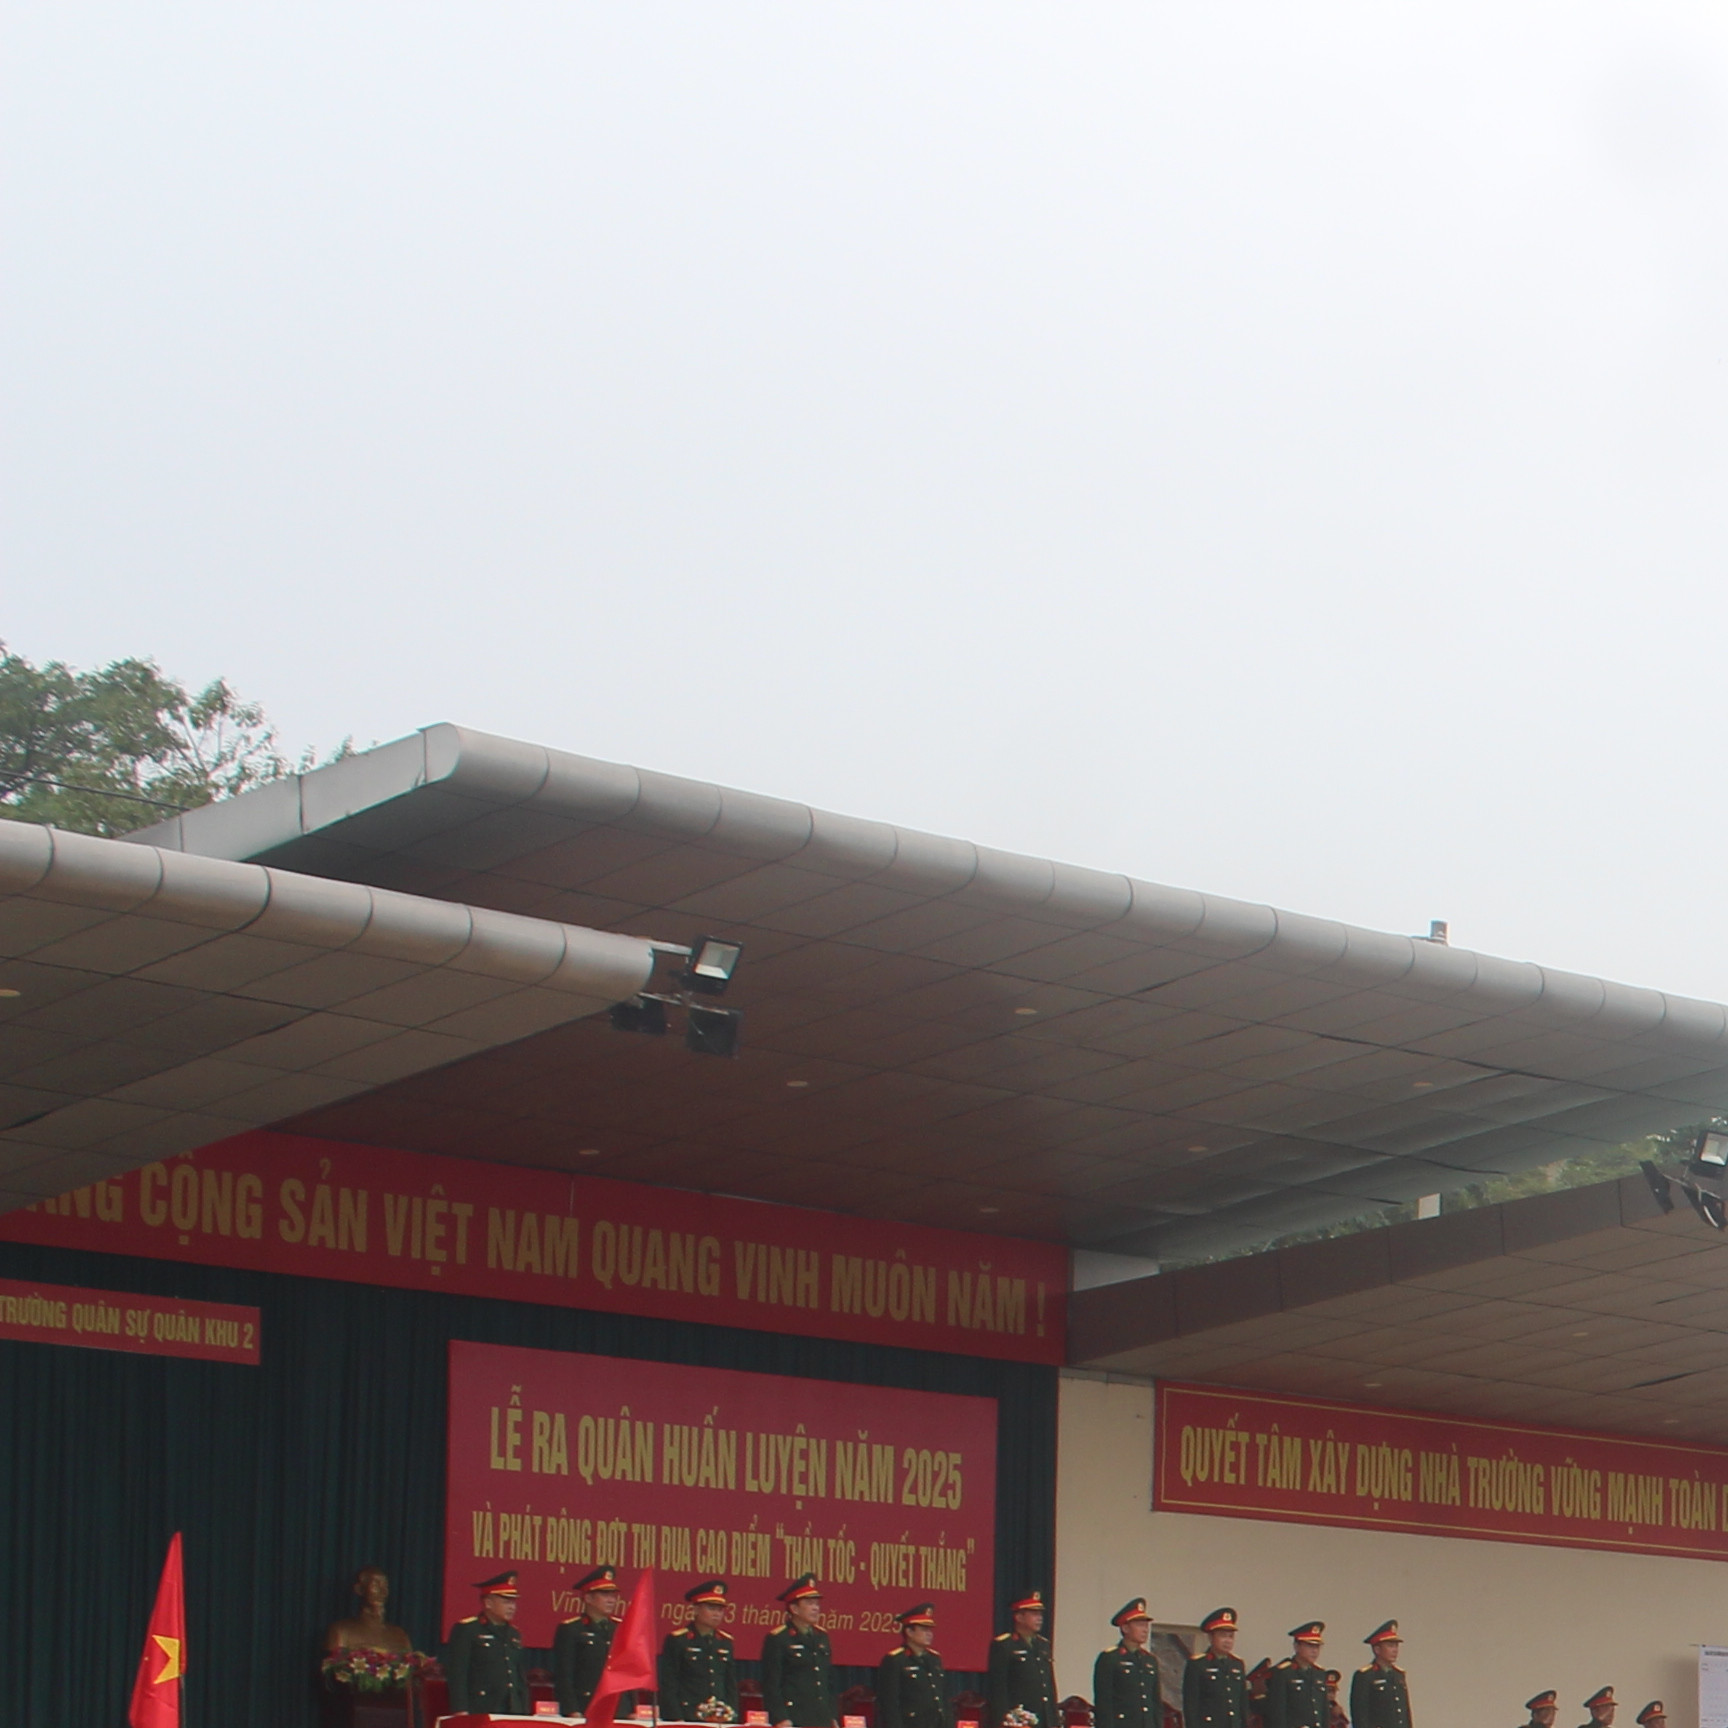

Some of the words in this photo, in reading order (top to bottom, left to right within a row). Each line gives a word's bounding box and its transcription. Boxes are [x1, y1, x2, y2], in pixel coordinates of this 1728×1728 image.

[278, 1157, 368, 1253] SẢN
[384, 1183, 474, 1277] VIỆT
[487, 1207, 580, 1279] NAM
[591, 1219, 720, 1297] QUANG
[734, 1240, 820, 1309] VINH
[830, 1248, 937, 1325] MUÔN
[947, 1259, 1027, 1336] NĂM
[72, 1300, 121, 1335] QUÂN
[125, 1308, 152, 1344] SỰ
[153, 1310, 202, 1344] QUÂN
[205, 1317, 240, 1348] KHU
[243, 1322, 254, 1349] 2
[490, 1385, 523, 1472] LỄ
[532, 1410, 569, 1476] RA
[577, 1405, 655, 1486] QUÂN
[662, 1406, 737, 1490] HUẤN
[745, 1423, 828, 1510] LUYỆN
[834, 1429, 895, 1504] NĂM
[901, 1447, 963, 1511] 2025
[1180, 1413, 1250, 1487] QUYẾT
[1255, 1423, 1301, 1490] TÂM
[1308, 1429, 1350, 1496] XÂY
[1356, 1441, 1413, 1511] DỰNG
[1419, 1442, 1461, 1507] NHÀ
[1467, 1448, 1545, 1516] TRƯỜNG
[1551, 1457, 1602, 1521] VỮNG
[1607, 1471, 1664, 1535] MẠNH
[1669, 1470, 1717, 1531] TOÀN
[472, 1501, 494, 1559] VÀ
[499, 1504, 543, 1562] PHÁT
[546, 1507, 592, 1574] ĐỘNG
[632, 1522, 656, 1570] THI
[660, 1525, 691, 1573] ĐUA
[696, 1528, 727, 1576] CAO
[731, 1514, 771, 1578] ĐIỂM
[828, 1523, 856, 1585] TỐC
[870, 1531, 916, 1591] QUYẾT
